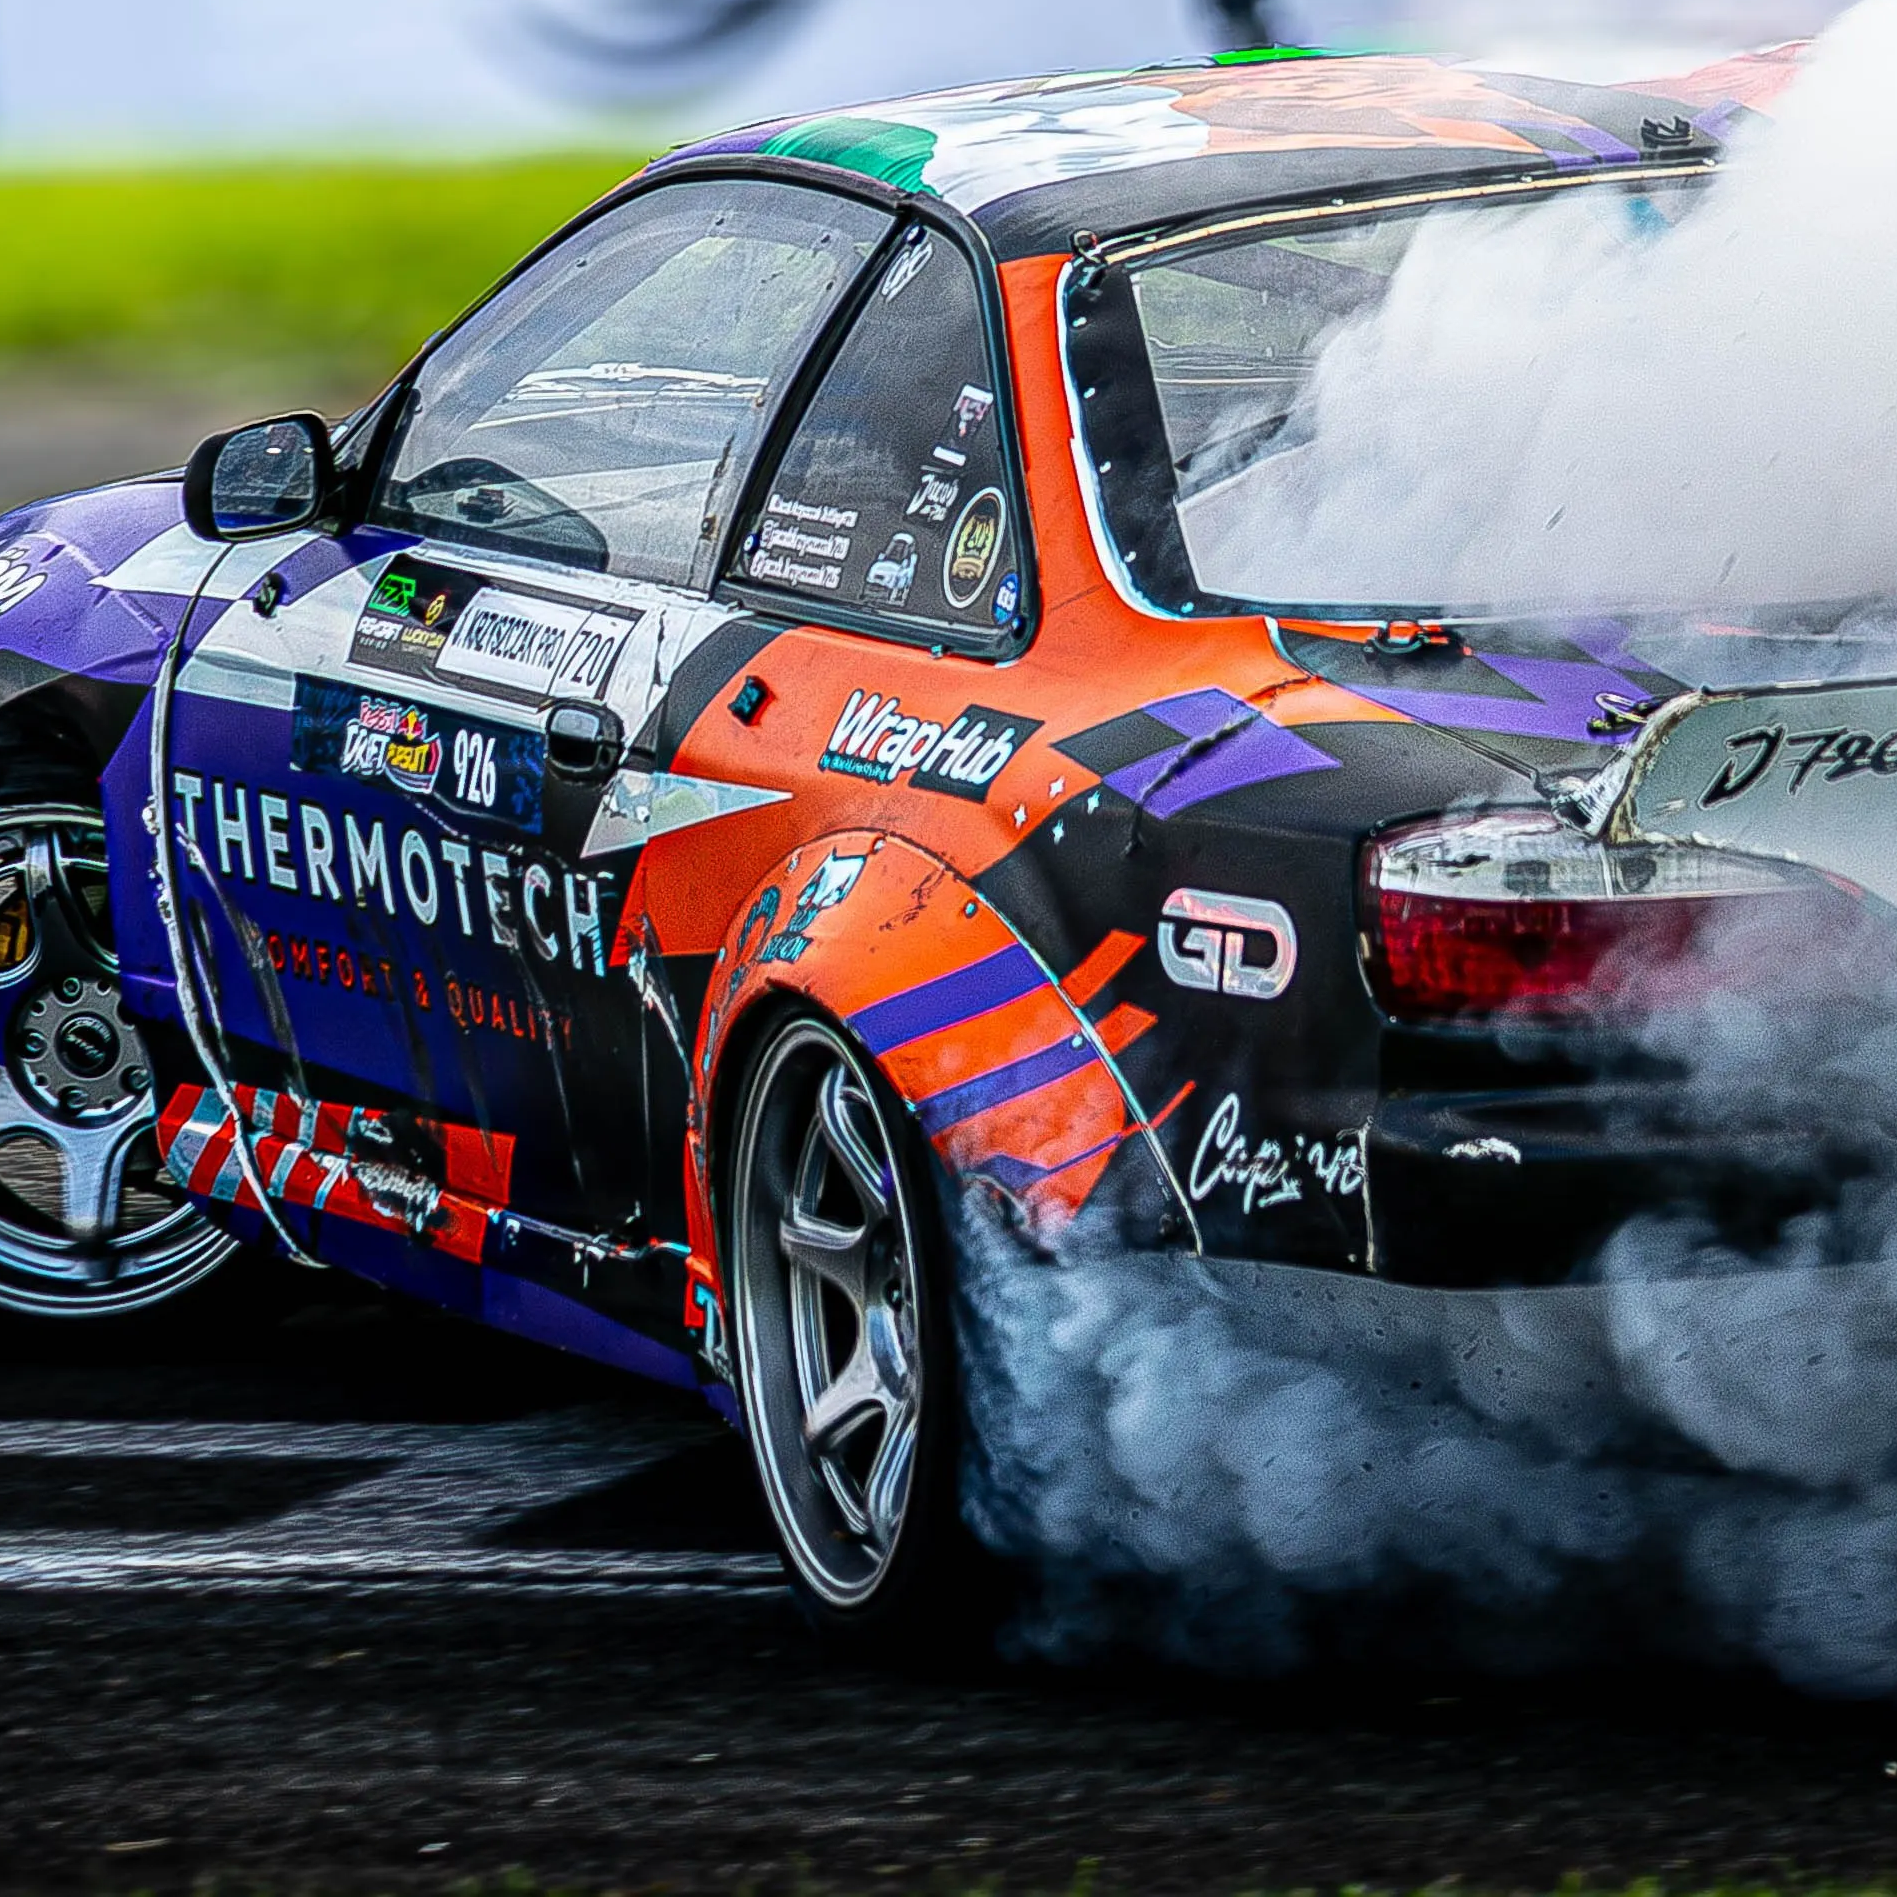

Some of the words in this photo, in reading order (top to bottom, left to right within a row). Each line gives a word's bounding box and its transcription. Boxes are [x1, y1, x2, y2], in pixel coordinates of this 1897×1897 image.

[559, 629, 616, 688] 720
[453, 728, 497, 808] 926
[827, 688, 1017, 786] WrapHub
[173, 770, 606, 977] THERMOTECH
[249, 930, 395, 1001] OMFORT
